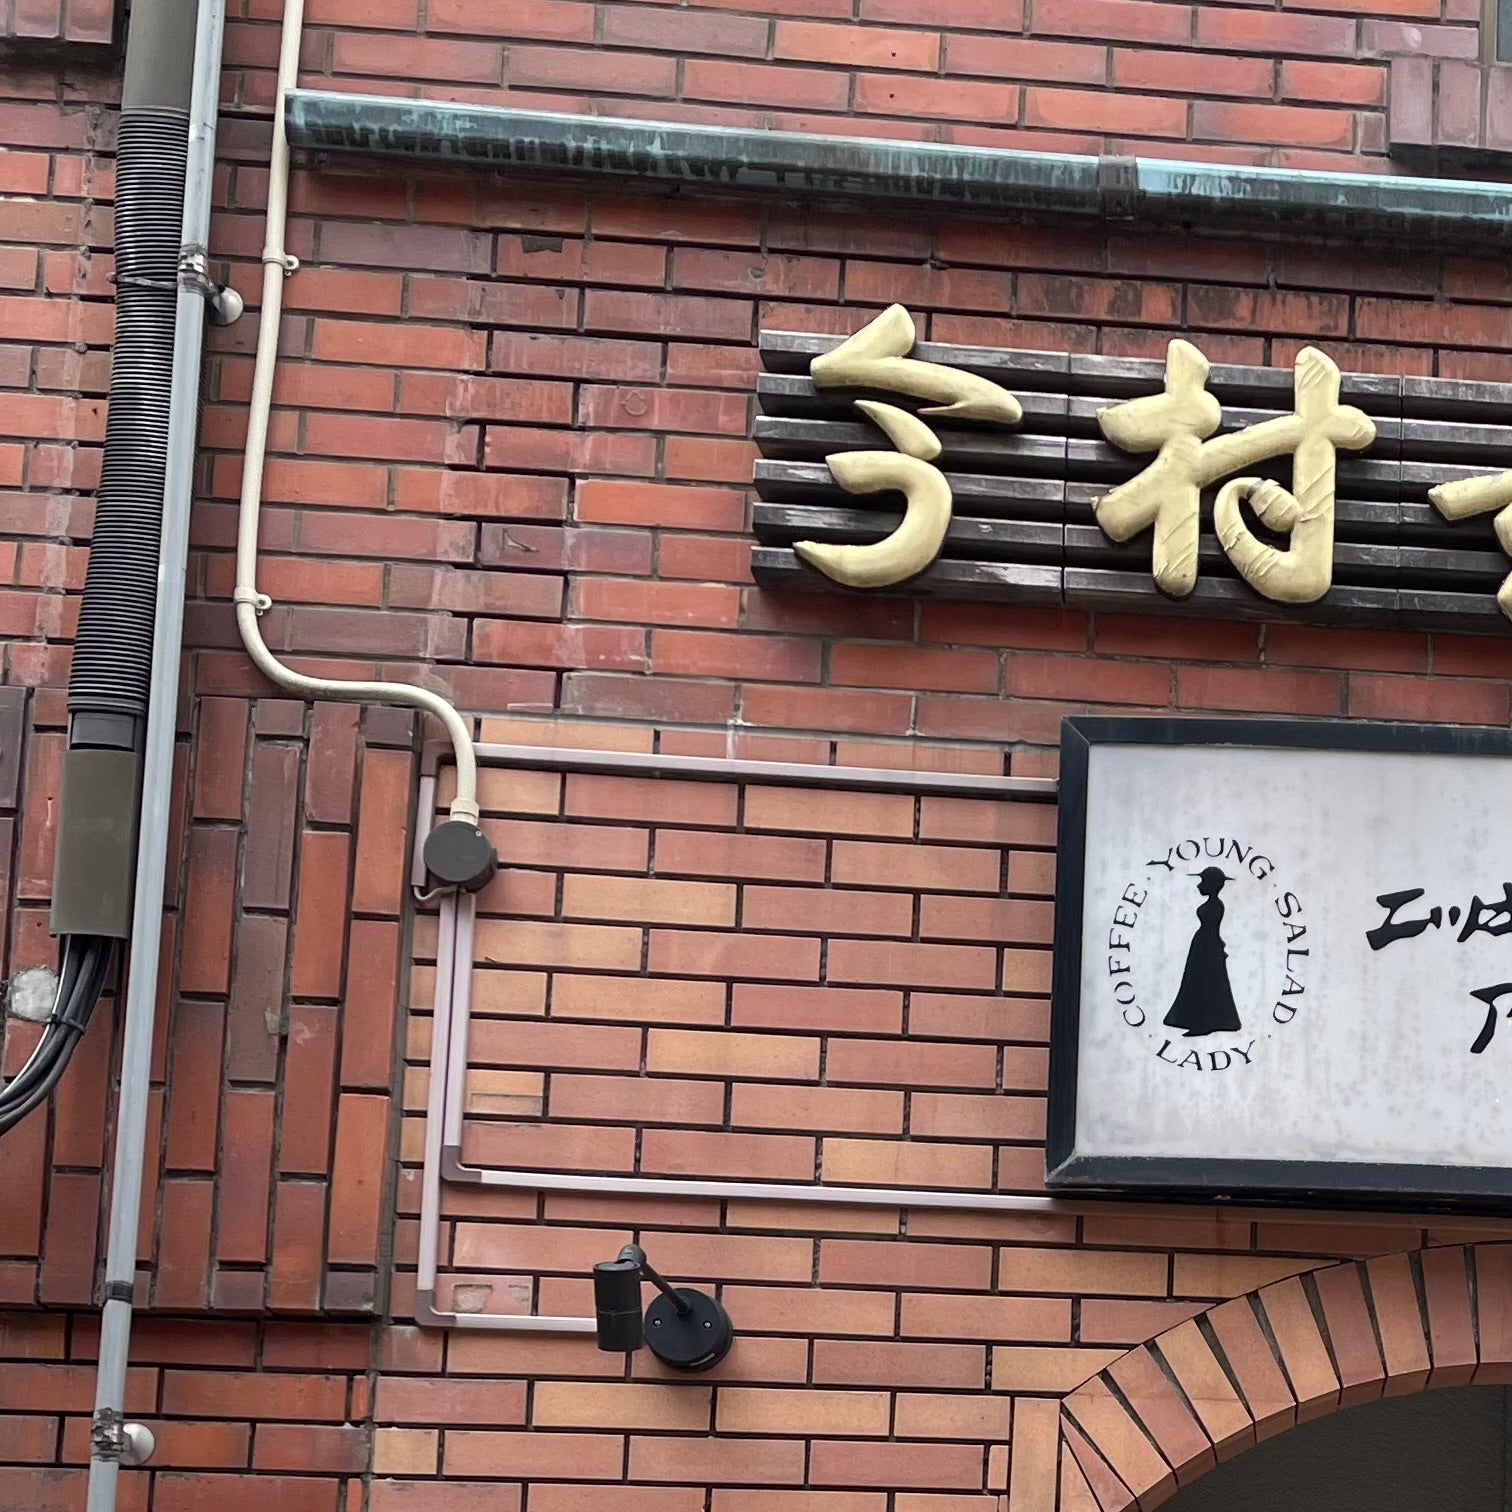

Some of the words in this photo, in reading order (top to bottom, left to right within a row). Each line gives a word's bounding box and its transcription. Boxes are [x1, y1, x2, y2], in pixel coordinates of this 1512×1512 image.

[1145, 837, 1276, 881] YOUNG
[1108, 882, 1148, 1028] COFFEE
[1272, 891, 1310, 1025] SALAD
[1155, 1039, 1256, 1072] LADY
